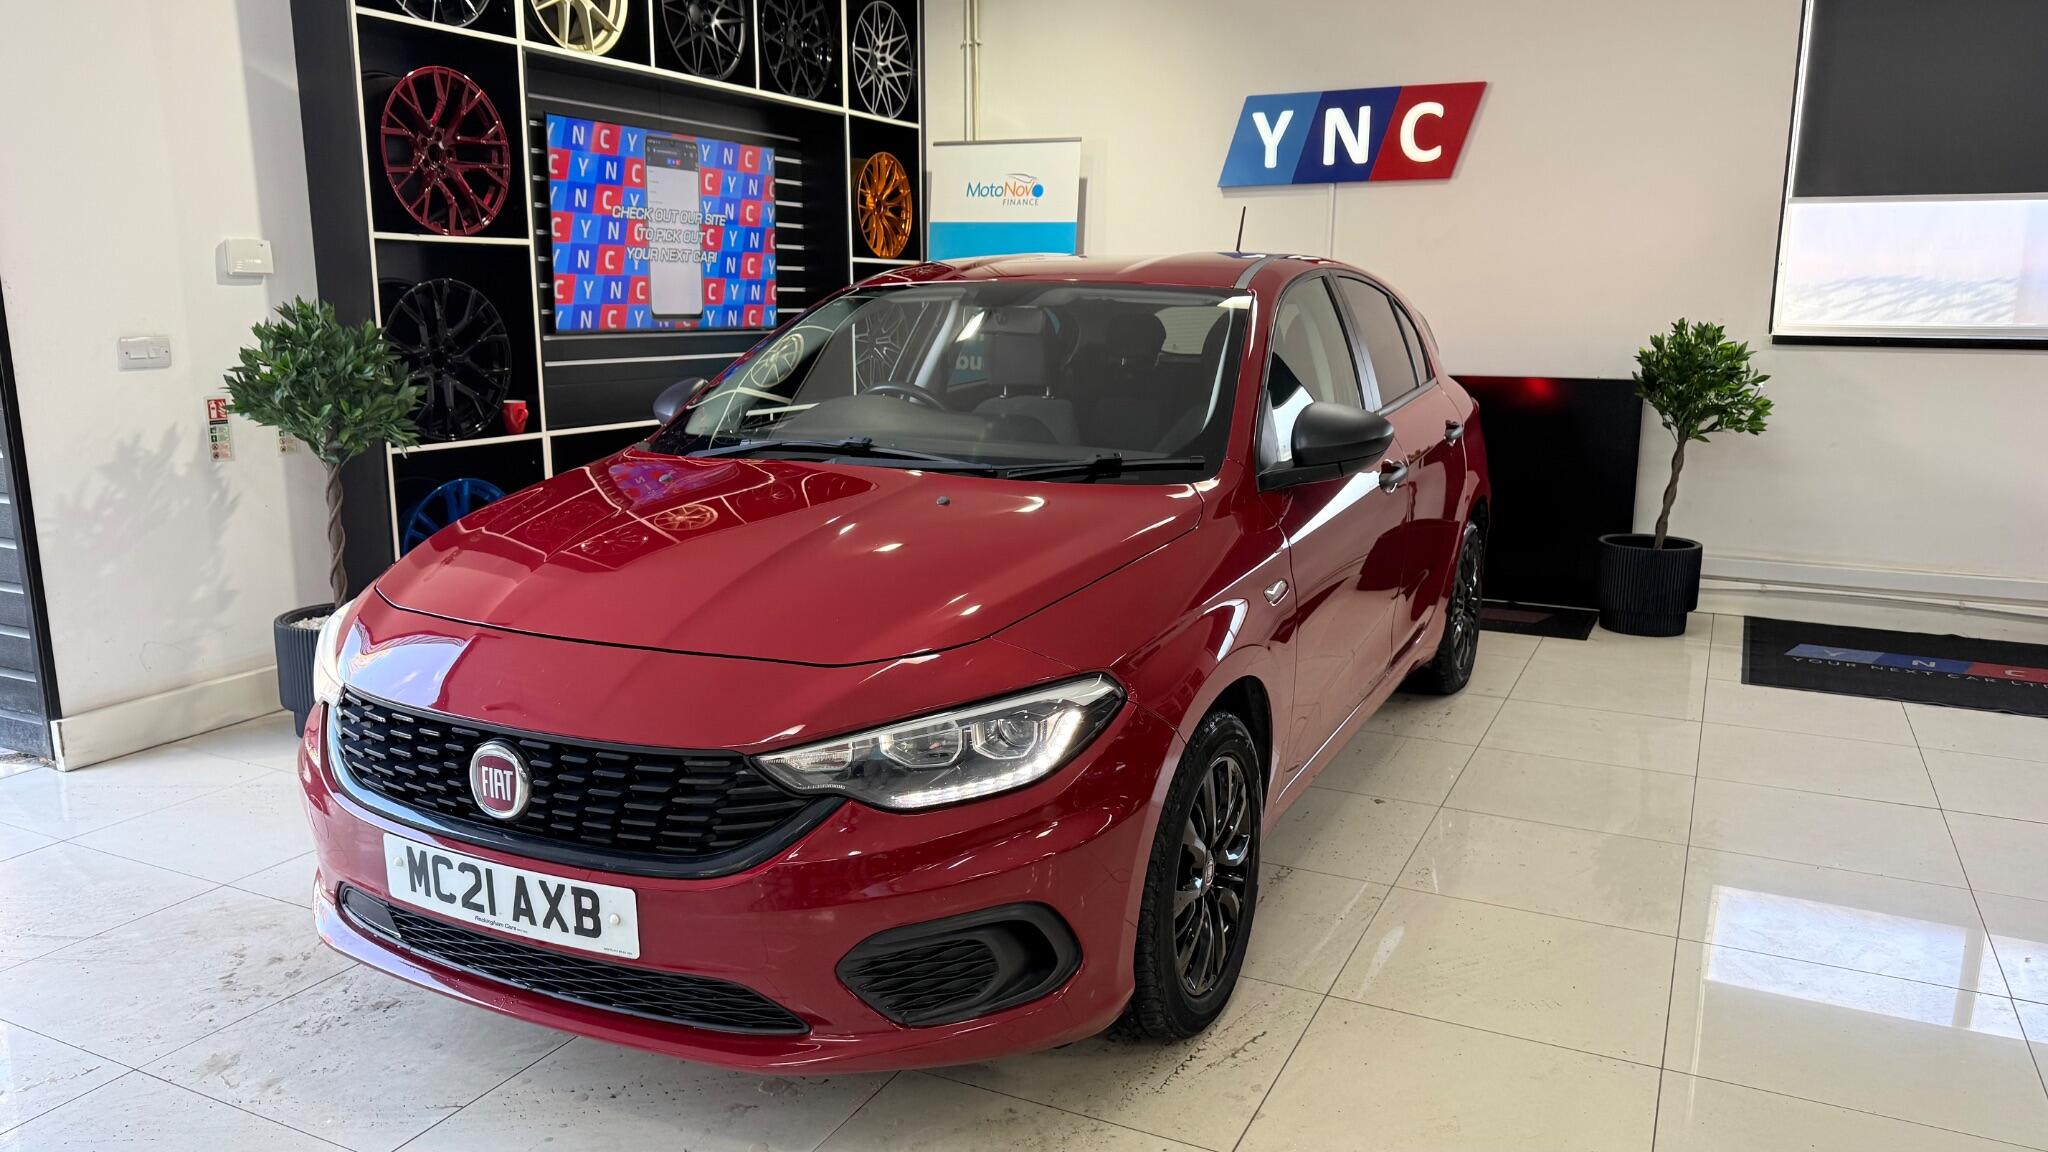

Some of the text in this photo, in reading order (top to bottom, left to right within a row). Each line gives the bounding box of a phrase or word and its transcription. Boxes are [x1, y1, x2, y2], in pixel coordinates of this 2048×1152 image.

[1252, 101, 1444, 168] YNC
[966, 180, 1044, 198] MotoNovo
[612, 205, 727, 227] CHECK OUT OUR SITE
[639, 227, 655, 241] TO
[656, 228, 683, 243] PICK
[683, 230, 706, 244] OUT
[627, 246, 660, 261] YOUR
[660, 248, 693, 263] NEXT
[1946, 672, 1996, 683] CAR
[481, 765, 514, 802] FIAT
[406, 845, 602, 939] MC21 AXB
